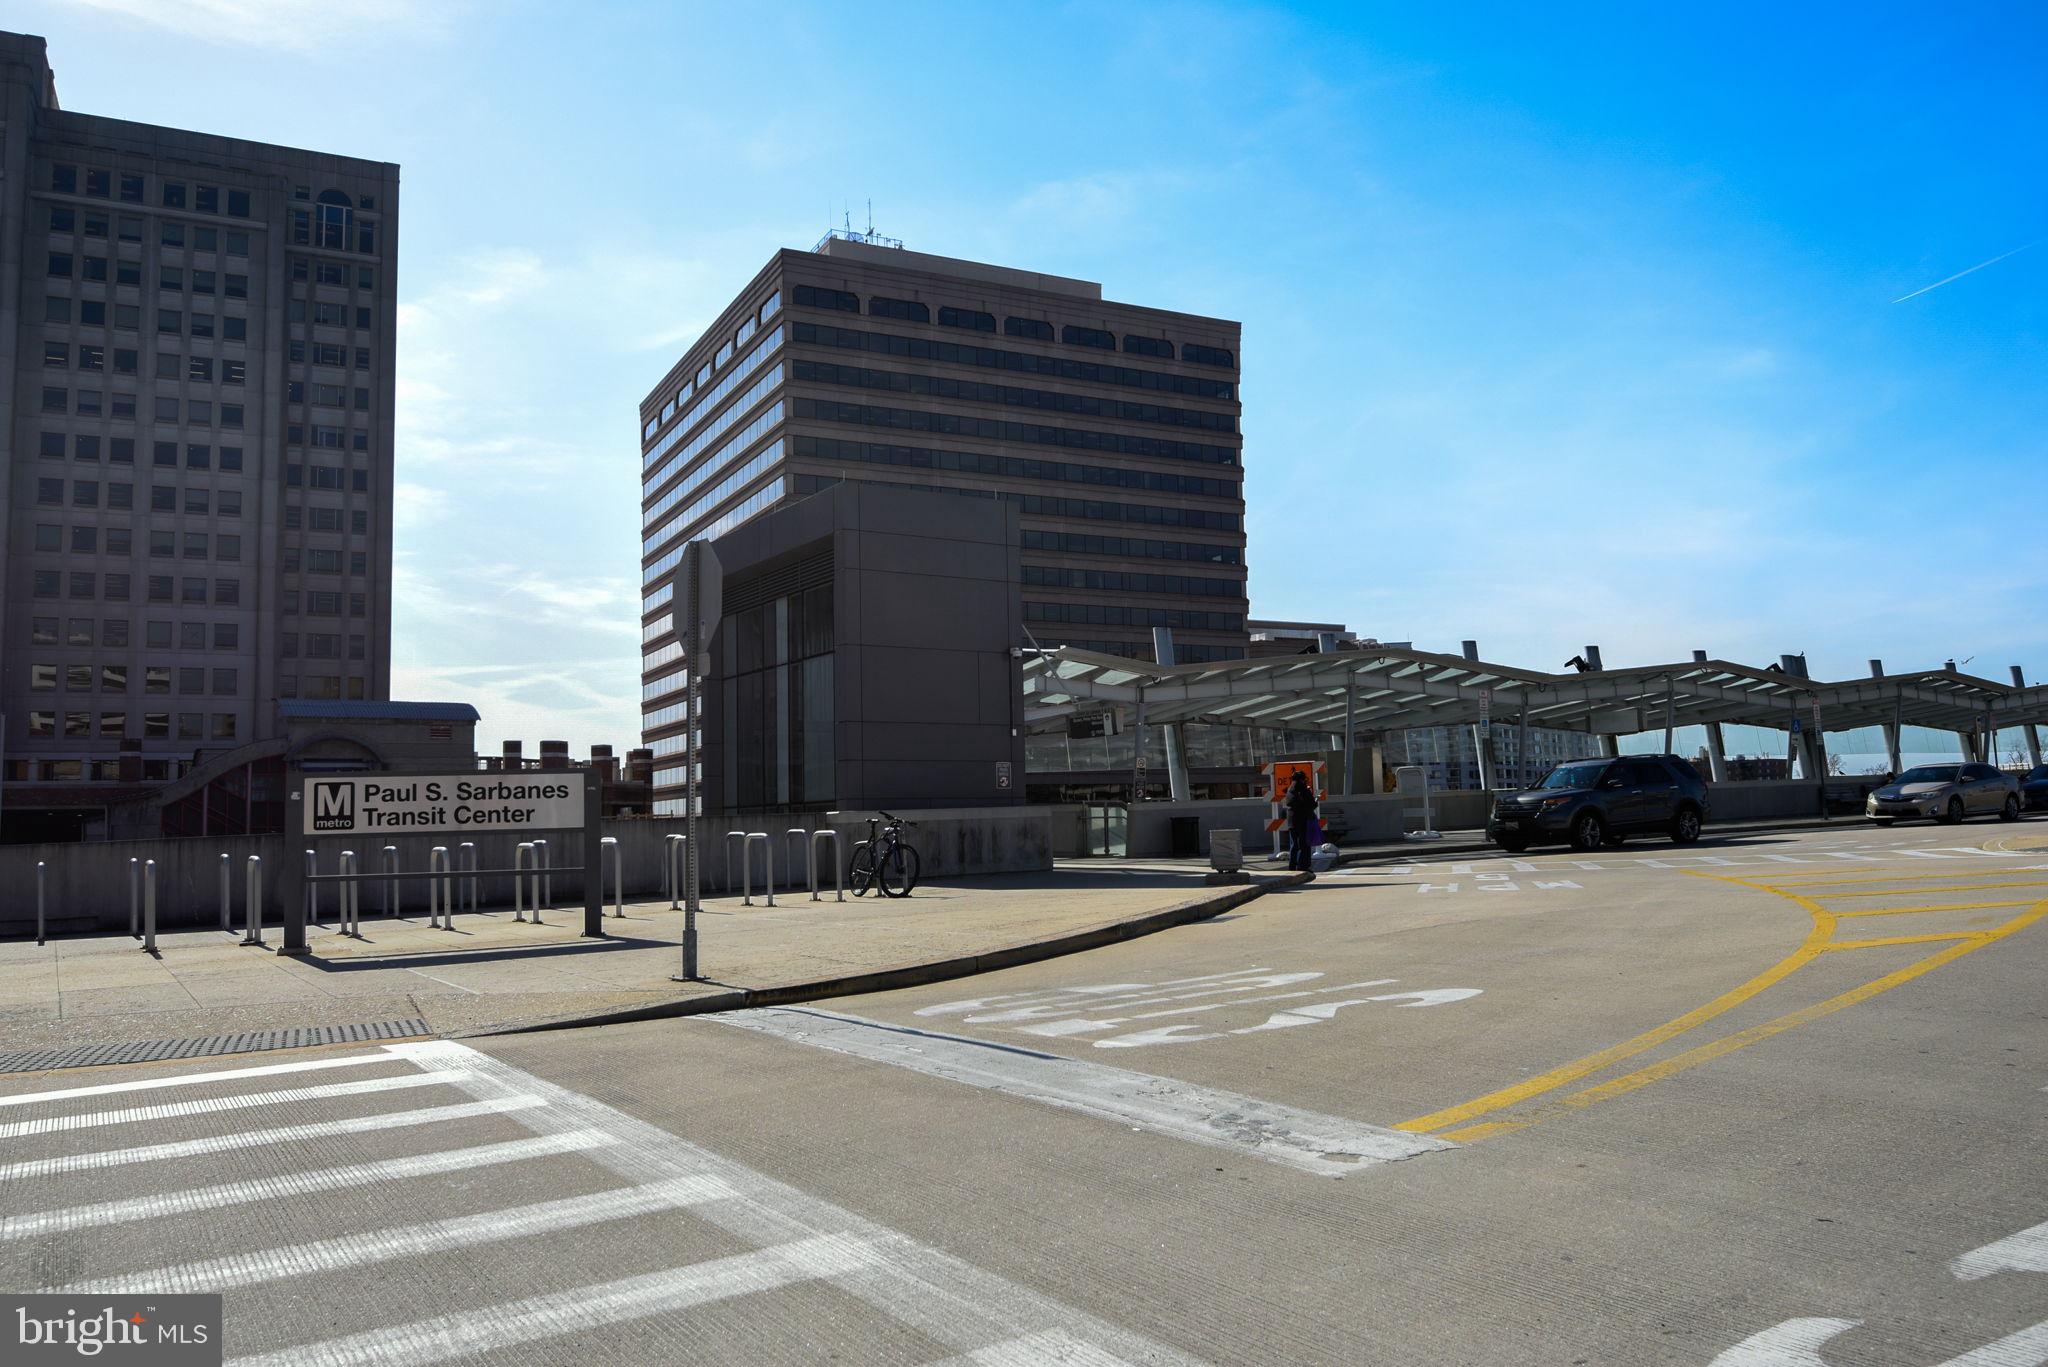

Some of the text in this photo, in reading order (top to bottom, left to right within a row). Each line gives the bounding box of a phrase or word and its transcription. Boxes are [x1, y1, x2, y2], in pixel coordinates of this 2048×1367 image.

[317, 784, 352, 817] M
[364, 782, 569, 803] Paul S. Sarbanes
[316, 819, 352, 829] metro
[362, 805, 535, 826] Transit Center
